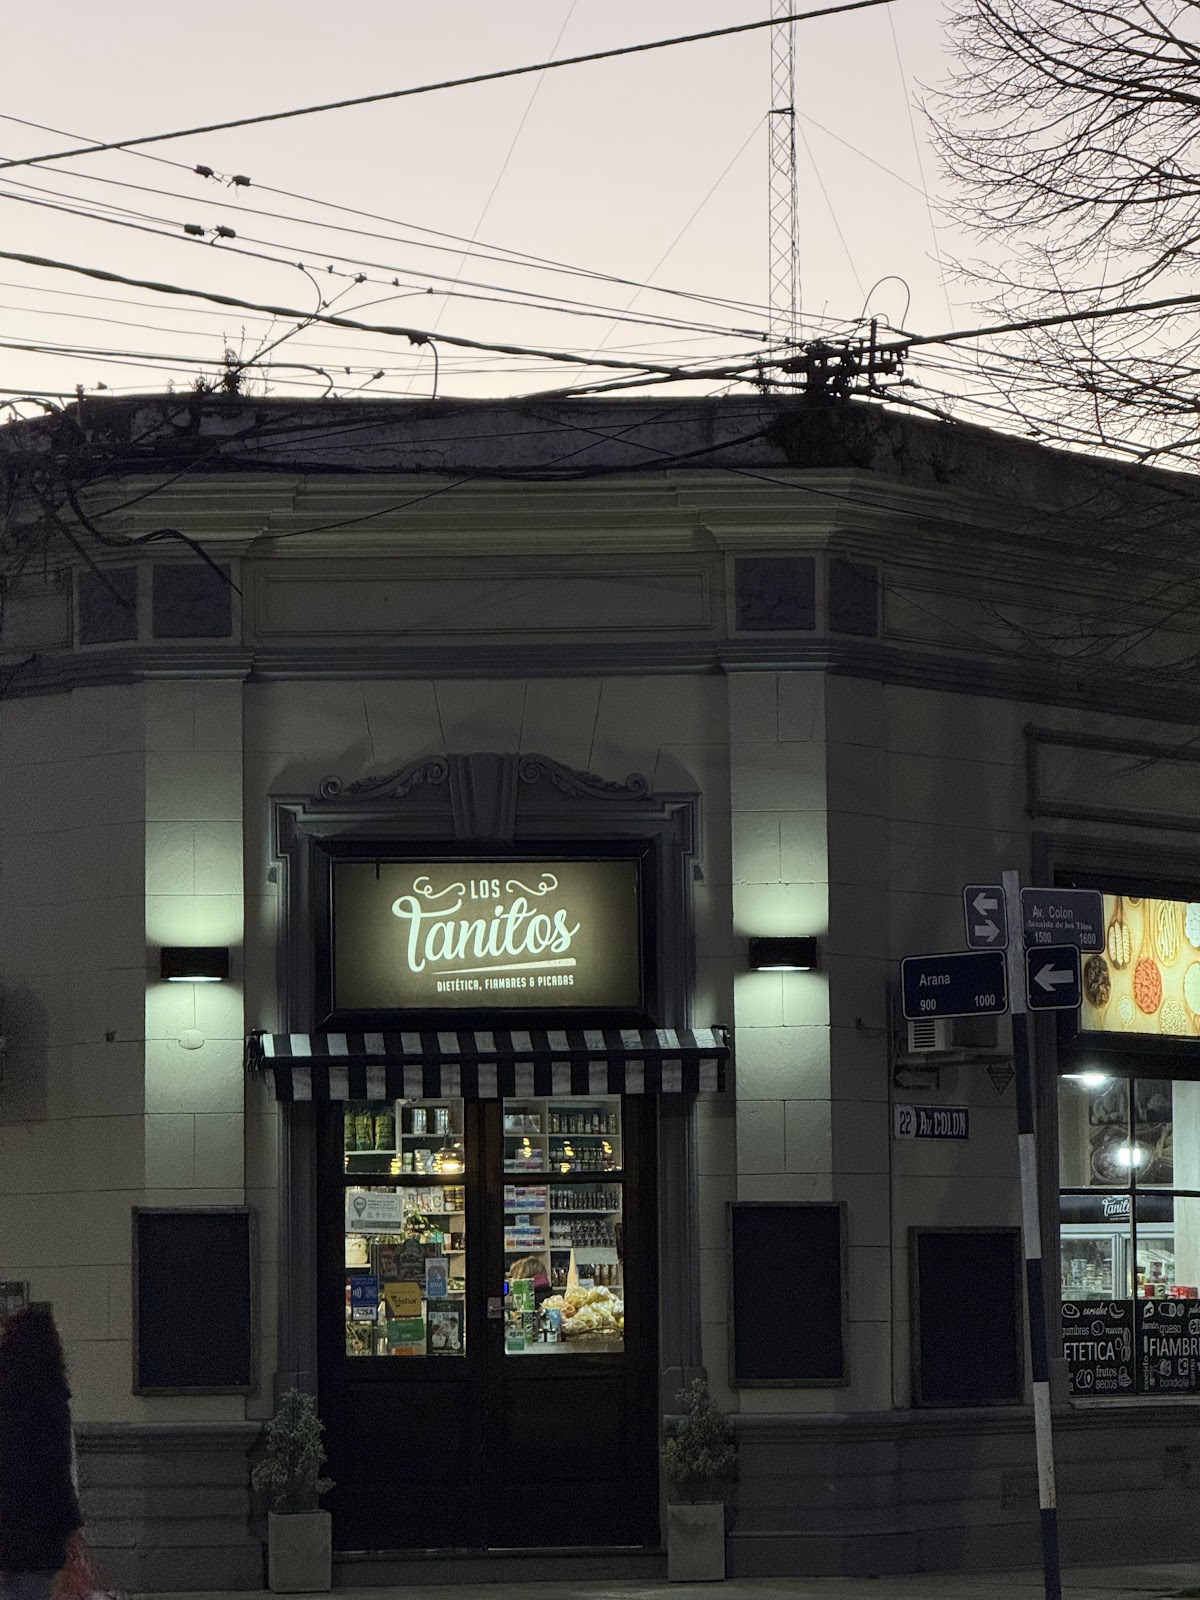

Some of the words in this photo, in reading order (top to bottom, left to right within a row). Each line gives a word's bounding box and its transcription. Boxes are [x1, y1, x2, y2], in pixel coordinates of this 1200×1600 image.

[470, 879, 500, 899] LOS
[1032, 905, 1045, 918] Av.
[1049, 905, 1074, 919] Colon
[1027, 920, 1054, 929] Avenida
[1055, 921, 1064, 929] de
[1065, 921, 1075, 930] los
[391, 895, 580, 972] Tanitos
[1034, 932, 1052, 943] 1500
[1079, 933, 1097, 945] 1600
[436, 978, 482, 992] DIETÉTICA,
[484, 977, 526, 990] FIAMBRES
[529, 976, 535, 988] &
[537, 974, 574, 987] PICADAS
[919, 973, 951, 986] Arana
[920, 999, 937, 1011] 900
[974, 994, 996, 1007] 1000
[899, 1110, 912, 1135] 22
[933, 1111, 966, 1137] COLON
[1159, 1324, 1181, 1337] queso
[1095, 1364, 1118, 1378] frutos
[1095, 1379, 1118, 1390] secos
[1159, 1377, 1190, 1389] bondiola
